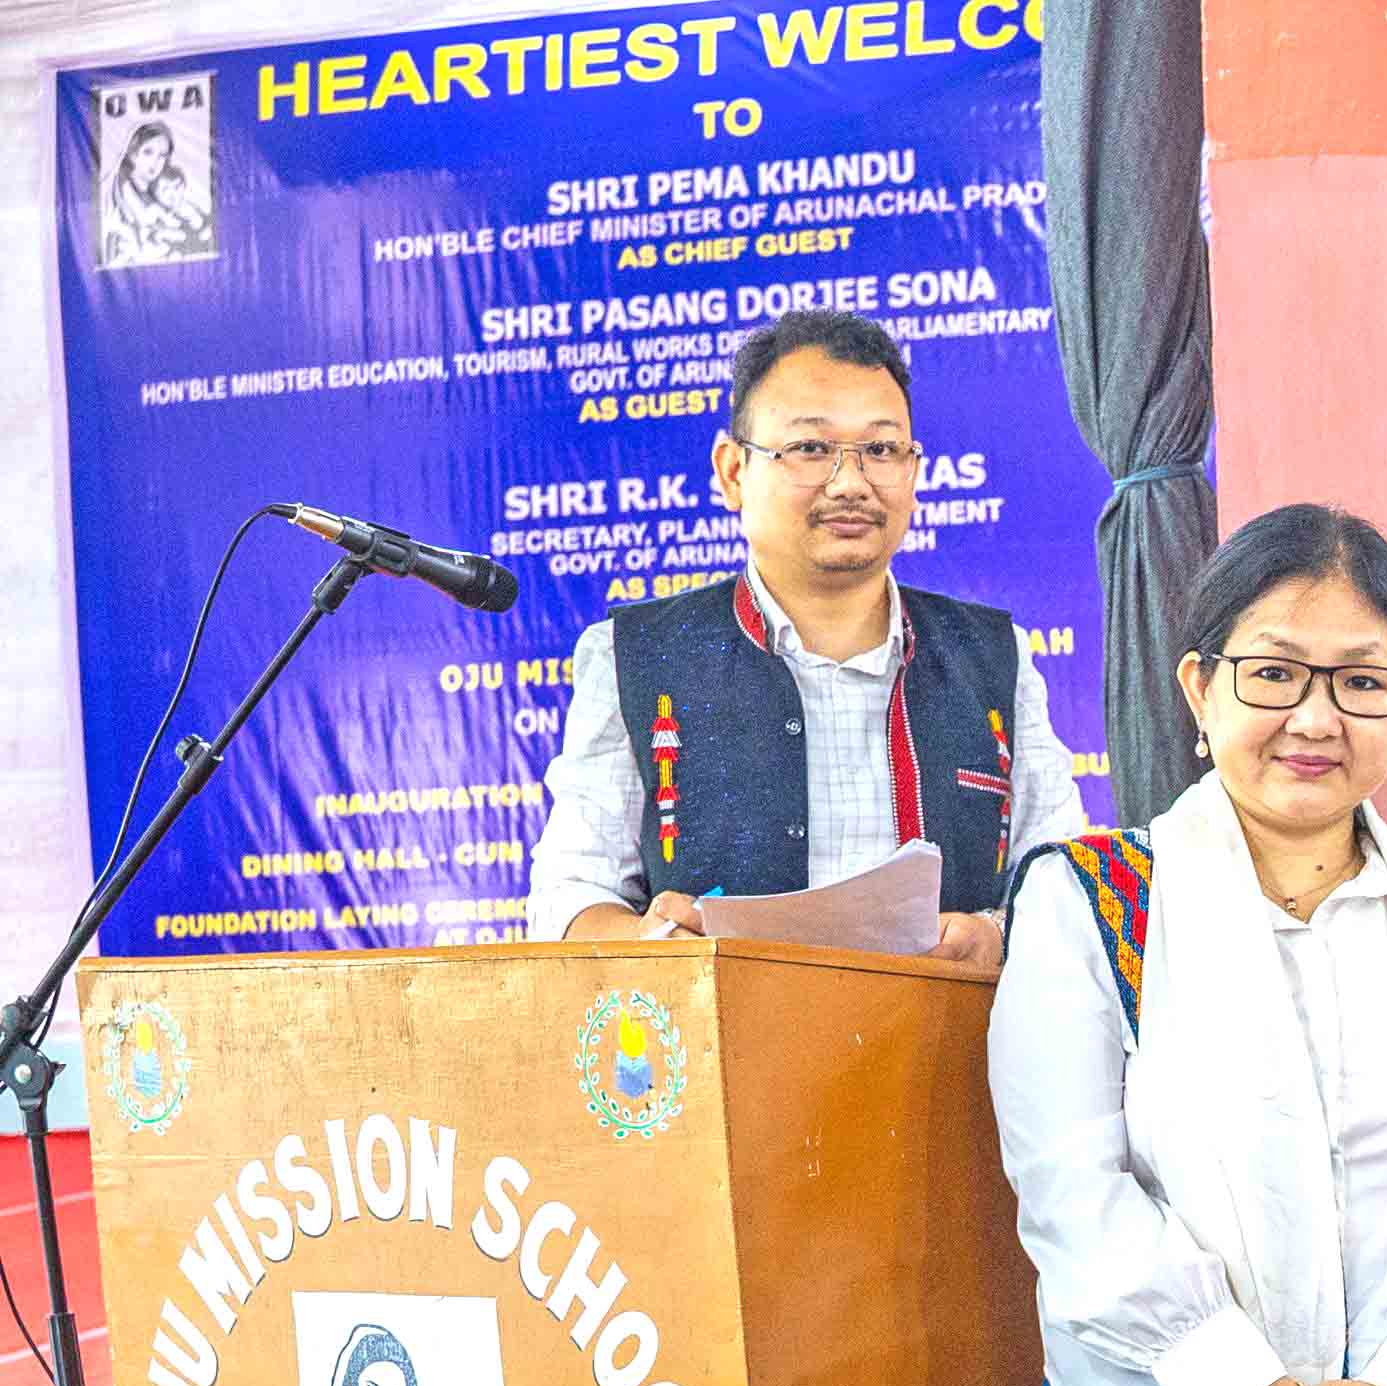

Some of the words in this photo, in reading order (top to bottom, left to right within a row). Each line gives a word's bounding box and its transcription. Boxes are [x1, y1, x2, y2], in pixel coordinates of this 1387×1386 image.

[258, 16, 736, 121] HEARTIEST
[693, 98, 762, 139] TO
[548, 175, 639, 215] SHRI
[648, 164, 750, 206] PEMA
[757, 149, 915, 195] KHANDU
[373, 228, 495, 262] HON'BLE
[500, 219, 584, 250] CHIEF
[590, 207, 722, 242] MINISTER
[728, 202, 768, 229] OF
[773, 187, 956, 226] ARUNACHAL
[617, 245, 657, 270] AS
[663, 236, 748, 265] CHIEF
[755, 226, 854, 257] GUEST
[481, 302, 572, 343] SHRI
[582, 288, 727, 334] PASANG
[737, 274, 878, 320] DORJEE
[887, 266, 997, 309] SONA
[231, 367, 323, 397] MINISTER
[328, 356, 449, 389] EDUCATION,
[453, 347, 552, 378] TOURISM,
[557, 339, 630, 369] RURAL
[632, 332, 713, 361] WORKS
[570, 367, 632, 395] GOVT.
[636, 364, 667, 389] OF
[579, 397, 618, 423] AS
[625, 388, 722, 420] GUEST
[504, 480, 607, 521] SHRI
[618, 474, 698, 512] R.K.
[490, 521, 652, 557] SECRETARY,
[550, 550, 620, 576] GOVT.
[624, 546, 657, 571] OF
[607, 577, 645, 601] AS
[440, 662, 503, 692] OJU
[513, 708, 558, 736] ON
[242, 850, 344, 879] DINING
[353, 845, 429, 871] HALL
[455, 840, 523, 867] CUM
[155, 908, 317, 939] FOUNDATION
[323, 901, 419, 929] LAYING
[177, 1113, 457, 1336] MISSION
